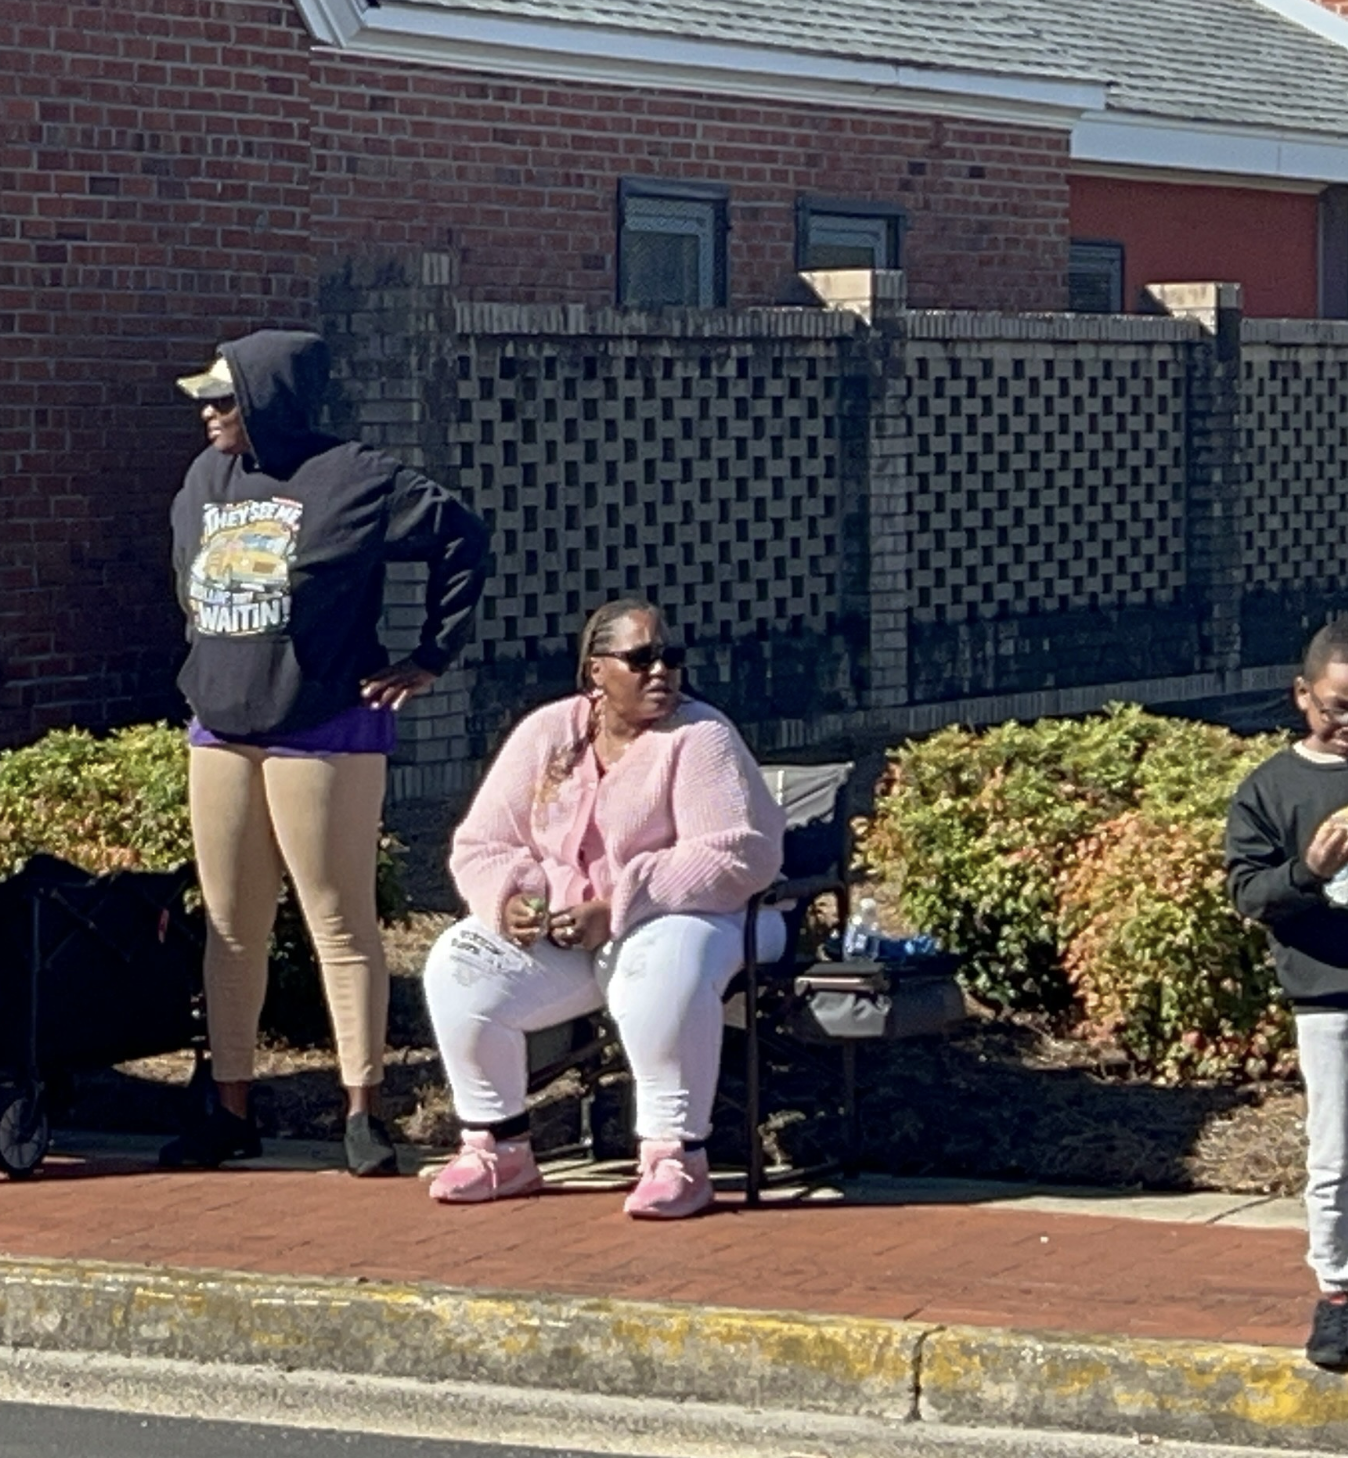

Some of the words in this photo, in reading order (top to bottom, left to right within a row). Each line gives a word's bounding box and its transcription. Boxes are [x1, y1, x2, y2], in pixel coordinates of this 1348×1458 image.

[204, 503, 251, 536] THEY
[249, 501, 278, 521] SEE
[273, 504, 302, 526] ME
